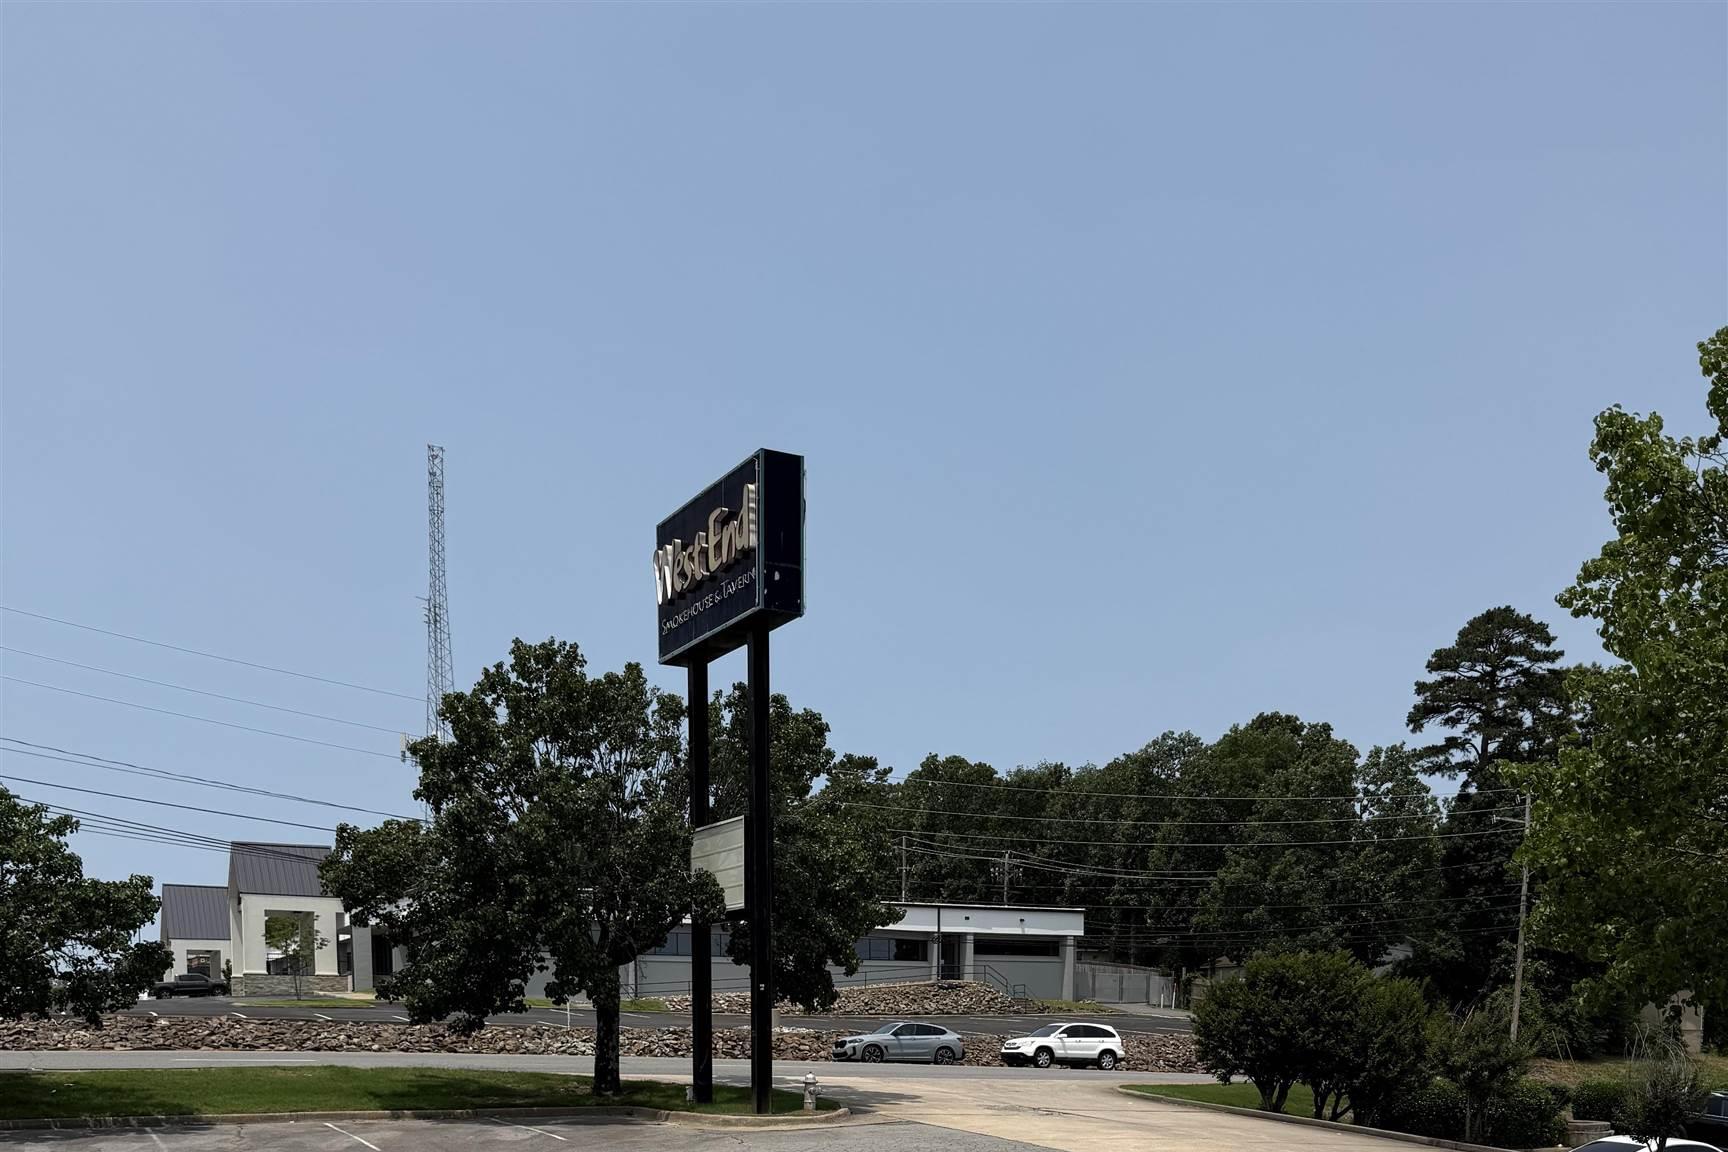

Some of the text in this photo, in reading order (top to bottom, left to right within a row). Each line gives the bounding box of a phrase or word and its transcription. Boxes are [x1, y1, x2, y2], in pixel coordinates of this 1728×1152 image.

[653, 484, 754, 604] West End
[662, 567, 756, 635] SMOKEHOUSE & TAVERN
